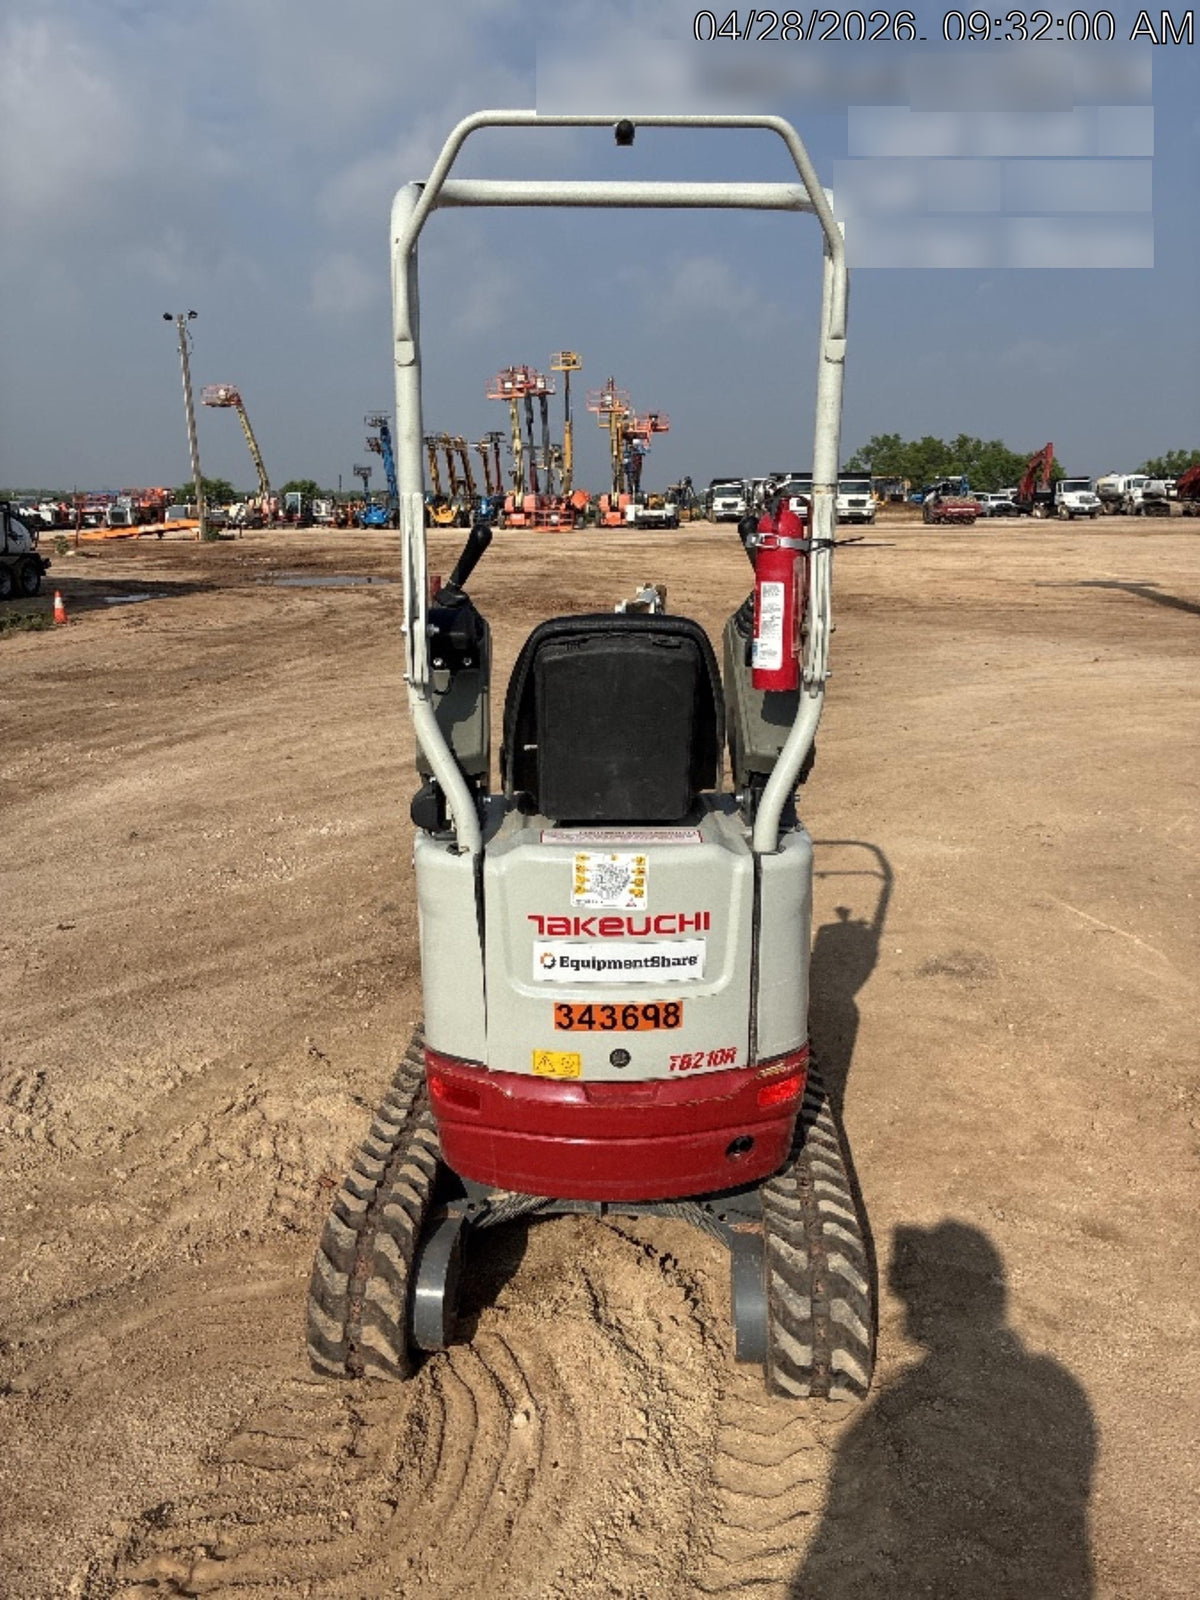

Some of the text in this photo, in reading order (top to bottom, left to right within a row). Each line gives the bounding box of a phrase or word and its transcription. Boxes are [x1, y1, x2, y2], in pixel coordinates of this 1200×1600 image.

[528, 912, 711, 937] TAKEUCHI
[559, 955, 698, 971] EquipmentShare
[556, 1003, 680, 1029] 343698
[669, 1047, 738, 1072] TB210R
